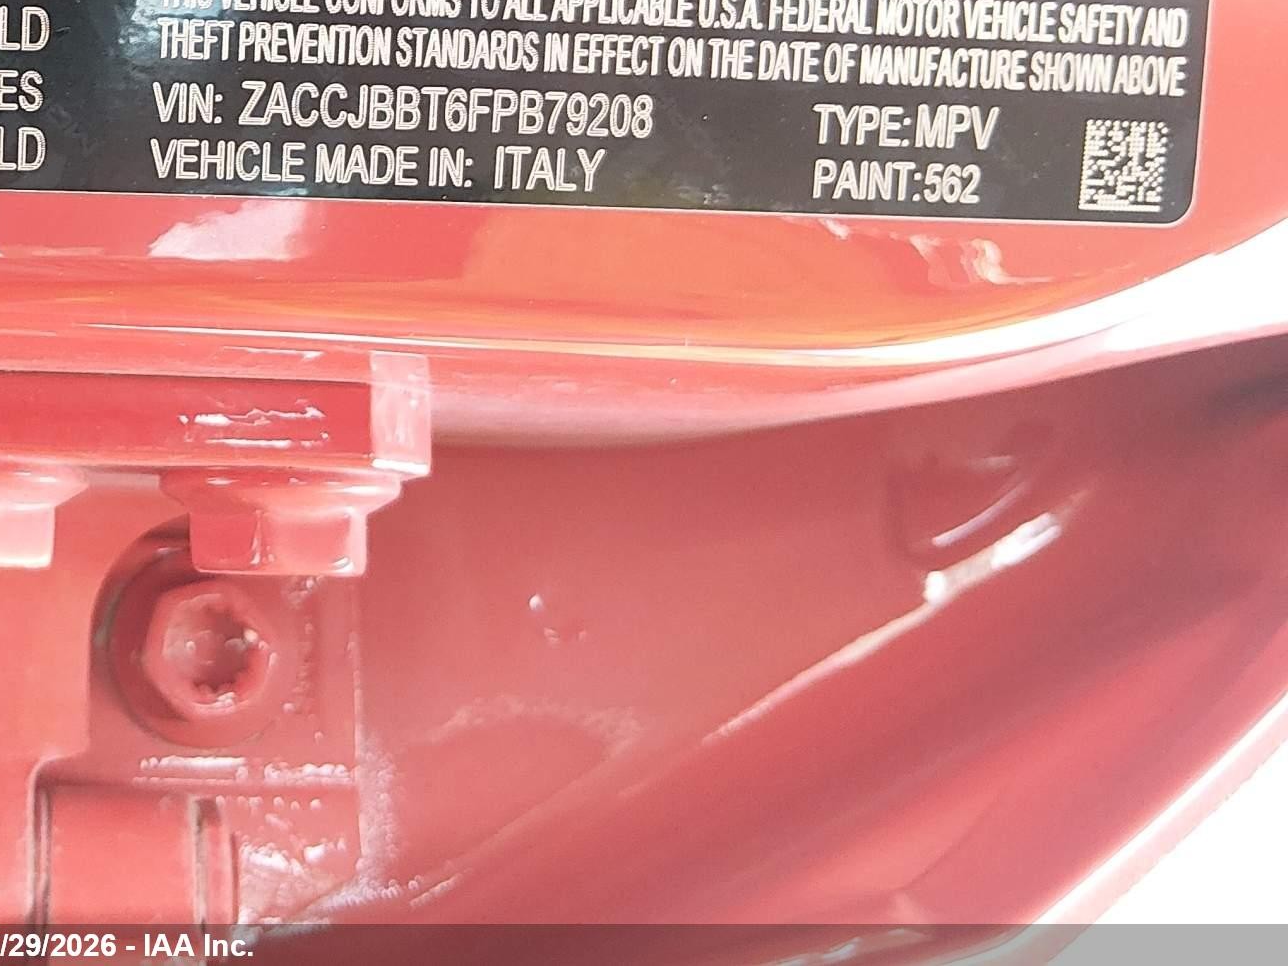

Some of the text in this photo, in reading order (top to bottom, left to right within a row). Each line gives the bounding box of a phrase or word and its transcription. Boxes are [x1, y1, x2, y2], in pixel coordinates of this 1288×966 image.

[964, 0, 1058, 43] VEHICLE
[1059, 3, 1142, 46] SAFETY
[1142, 7, 1189, 48] AND
[157, 17, 1187, 97] THEFT PREVENTION STANDARDS IN EFFECT ON THE DATE OF MANUFACTURE SHOWN ABOVE
[152, 81, 654, 139] VIN: ZACCJBBT6FPB79208
[150, 138, 608, 193] VEHICLE MADE IN: ITALY
